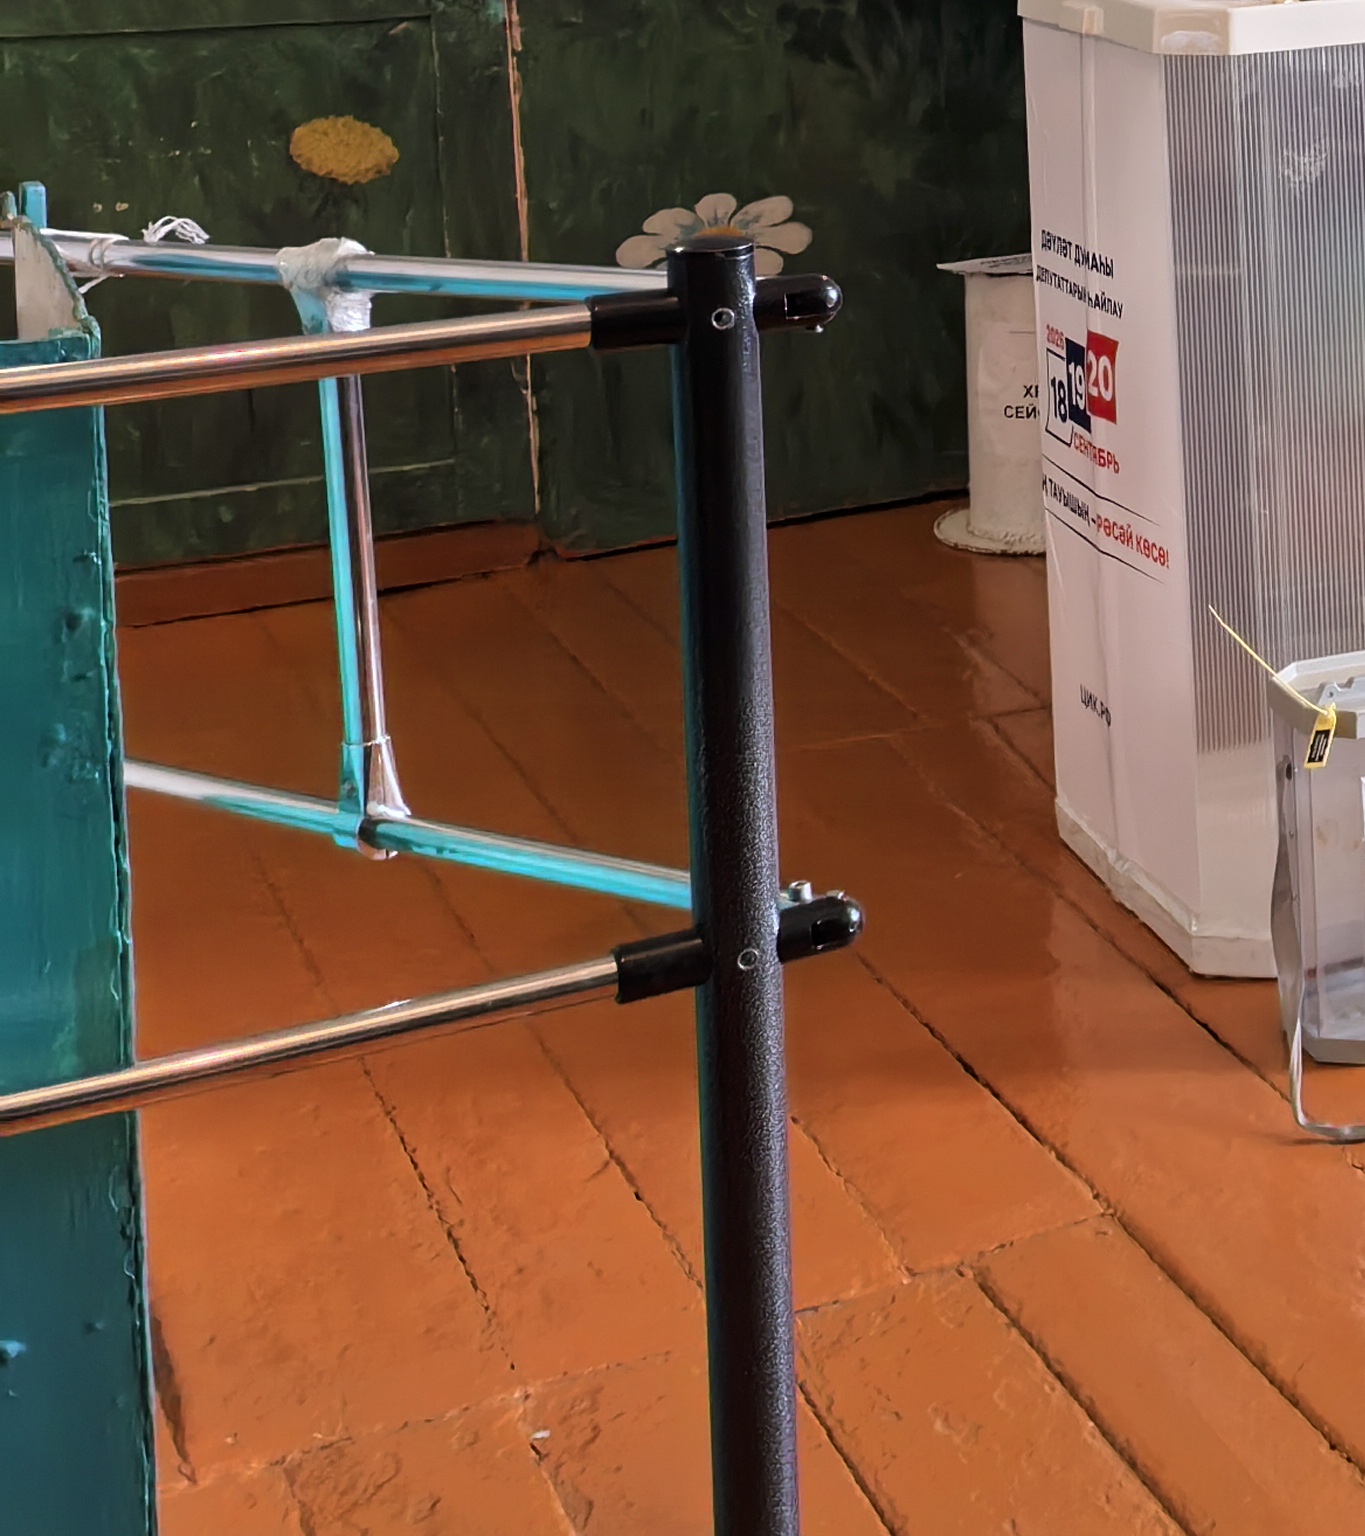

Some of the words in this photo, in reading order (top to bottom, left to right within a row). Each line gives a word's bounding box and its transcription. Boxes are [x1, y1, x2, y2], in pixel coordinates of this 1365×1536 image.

[1050, 376, 1068, 423] 18
[1068, 362, 1085, 410] 19
[1087, 349, 1113, 402] 20
[1003, 403, 1040, 419] СЕЙ
